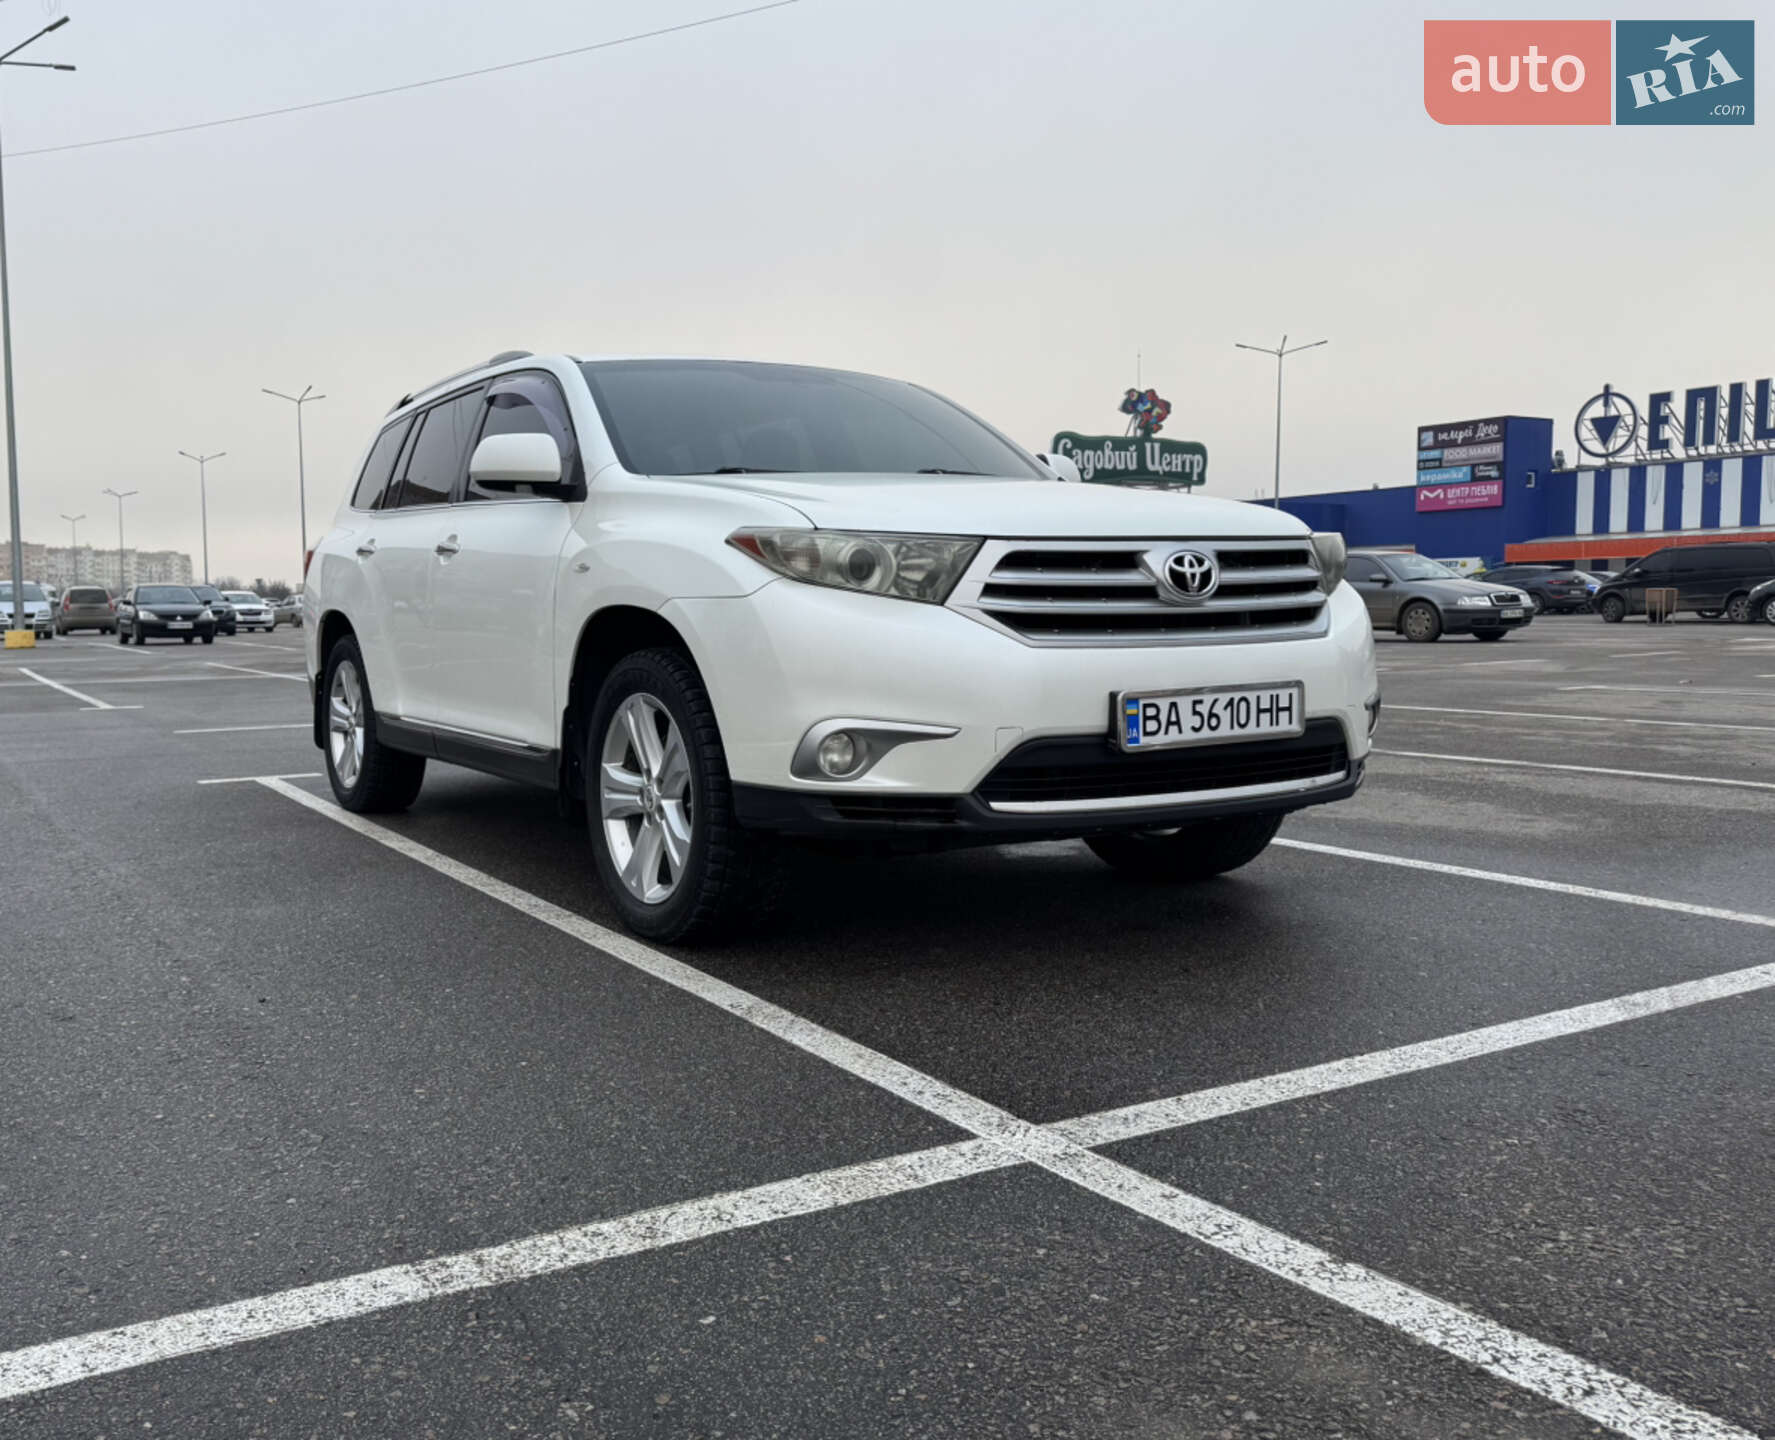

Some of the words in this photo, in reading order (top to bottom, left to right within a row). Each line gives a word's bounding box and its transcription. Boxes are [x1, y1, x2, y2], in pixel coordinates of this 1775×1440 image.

[1145, 442, 1204, 480] Центр
[1447, 486, 1470, 498] ЦЕНТР
[1142, 701, 1183, 737] BA
[1190, 696, 1250, 733] 5610
[1256, 692, 1293, 728] HH
